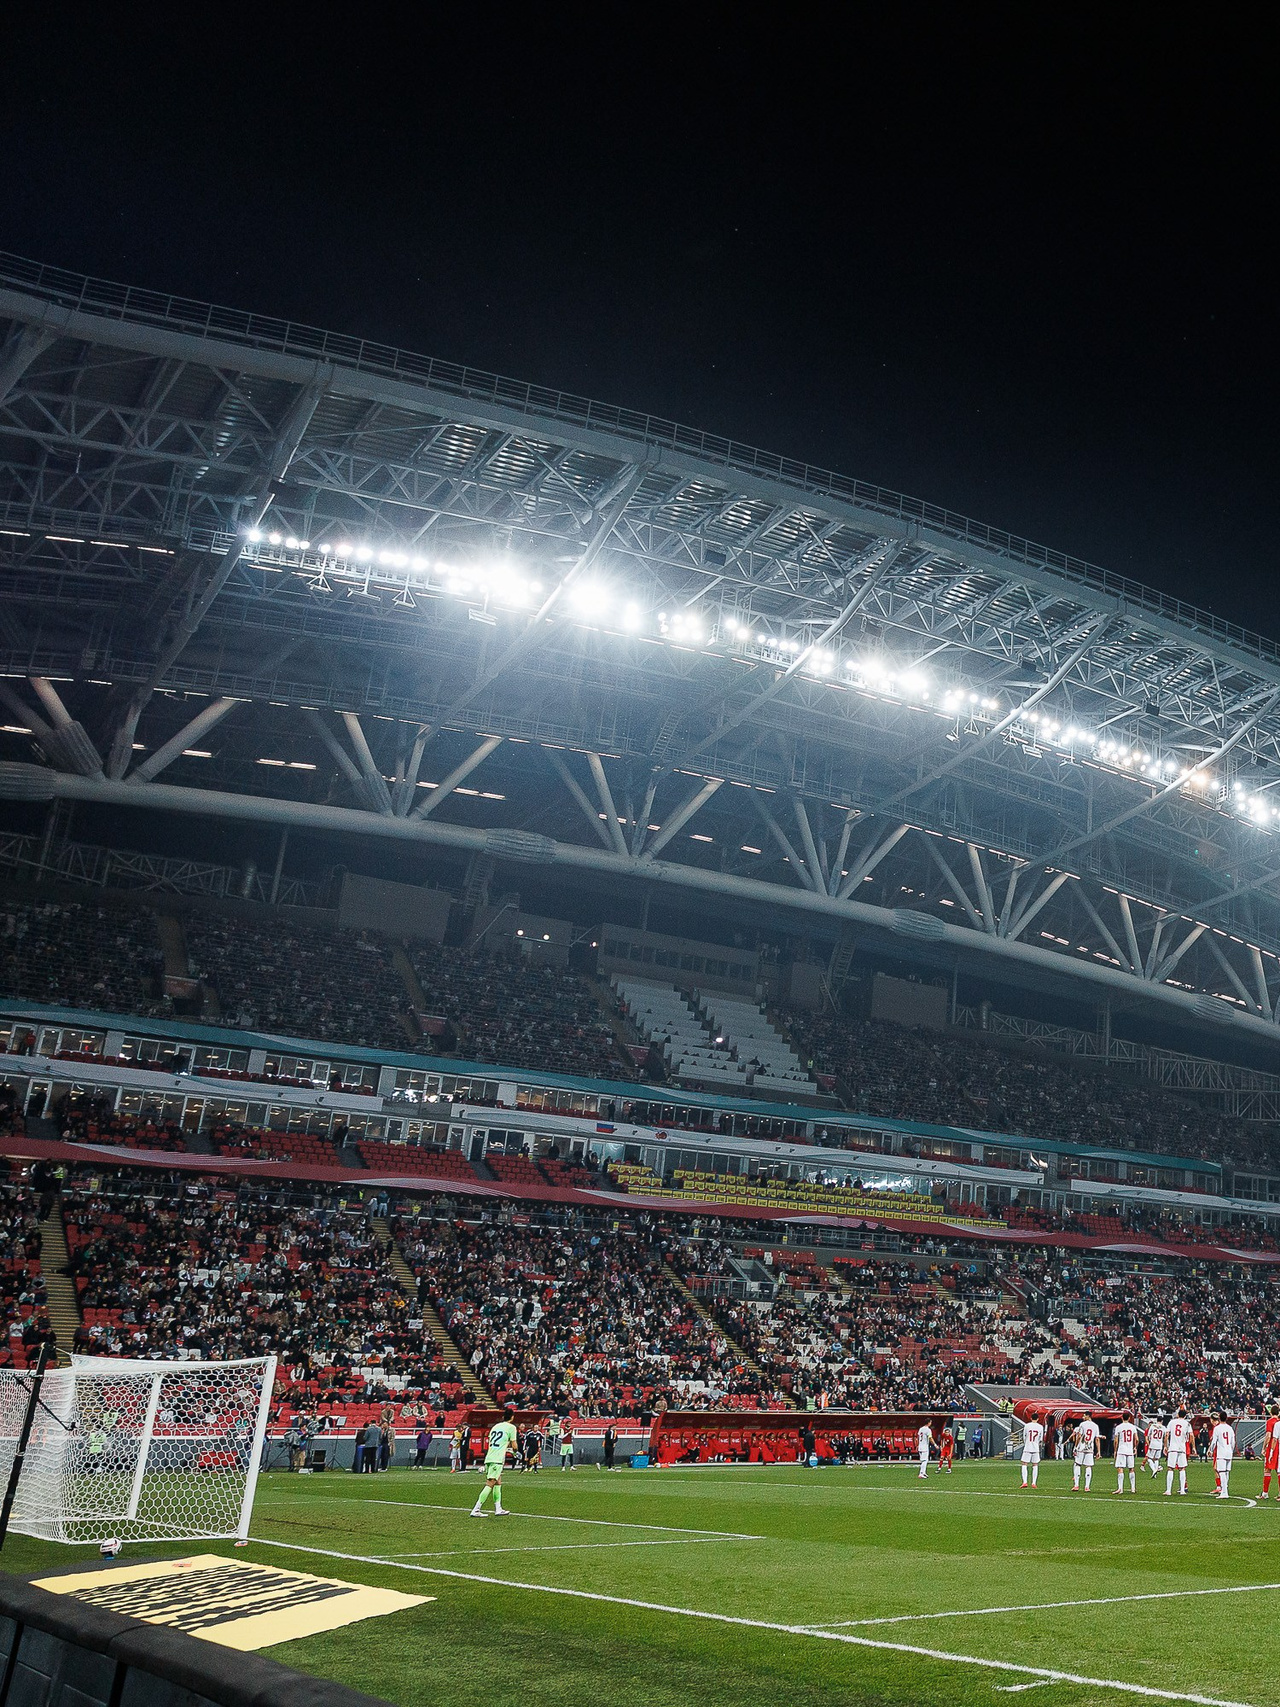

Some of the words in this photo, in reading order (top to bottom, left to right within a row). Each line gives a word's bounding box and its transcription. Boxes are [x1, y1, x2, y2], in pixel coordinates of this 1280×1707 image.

[1028, 1429, 1039, 1442] 17
[1085, 1428, 1093, 1442] 9
[1121, 1429, 1133, 1443] 19
[1153, 1428, 1163, 1440] 20
[1174, 1424, 1182, 1437] 6
[489, 1430, 504, 1447] 22
[1222, 1431, 1230, 1445] 4
